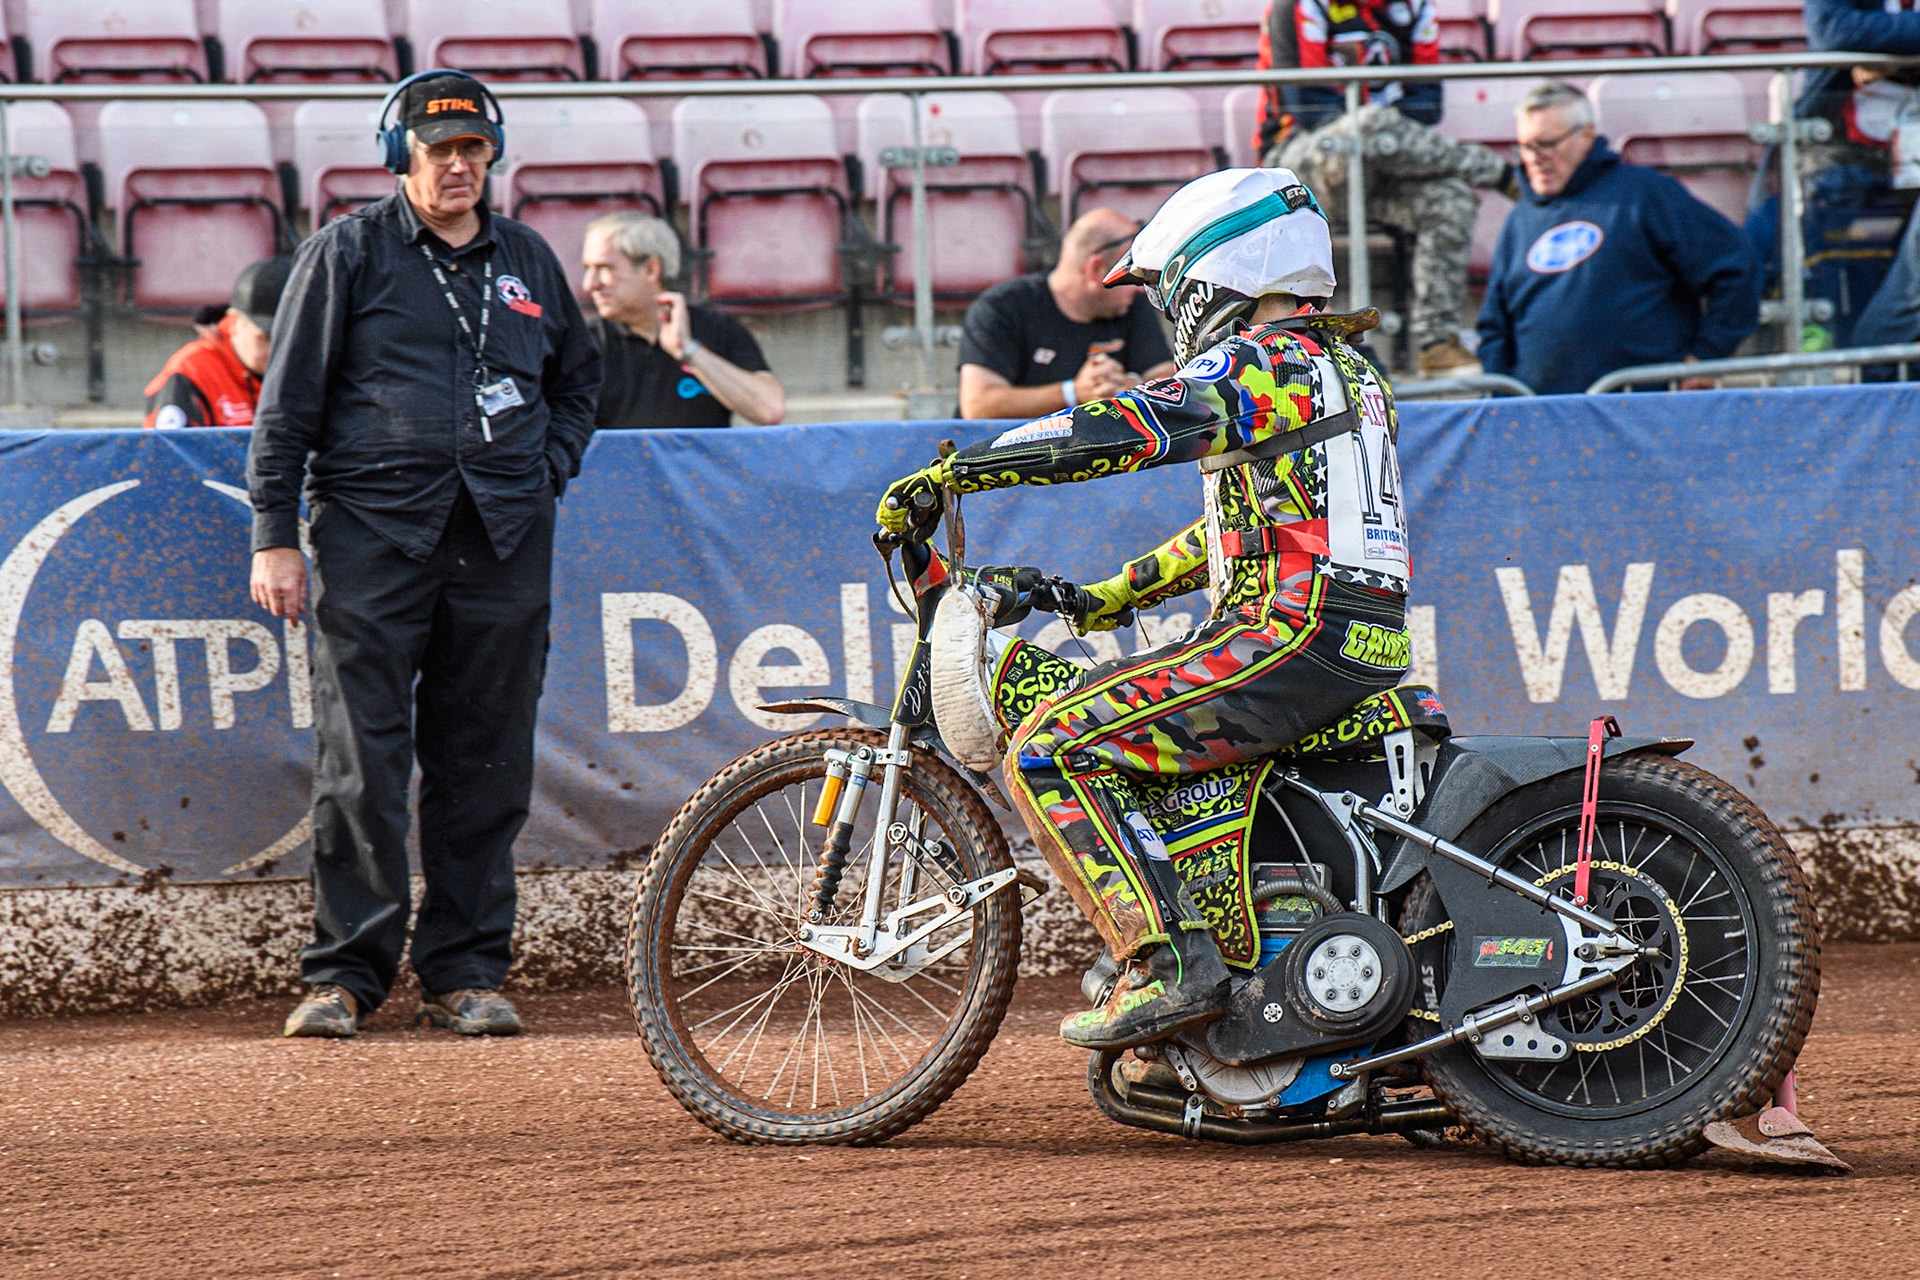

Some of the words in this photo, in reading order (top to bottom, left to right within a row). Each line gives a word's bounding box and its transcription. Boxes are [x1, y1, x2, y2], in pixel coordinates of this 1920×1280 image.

[426, 97, 479, 115] STIHL
[1036, 428, 1072, 439] SERVICES
[1366, 528, 1401, 543] BRITISH
[46, 618, 315, 734] ATPI
[1162, 777, 1236, 812] GROUP
